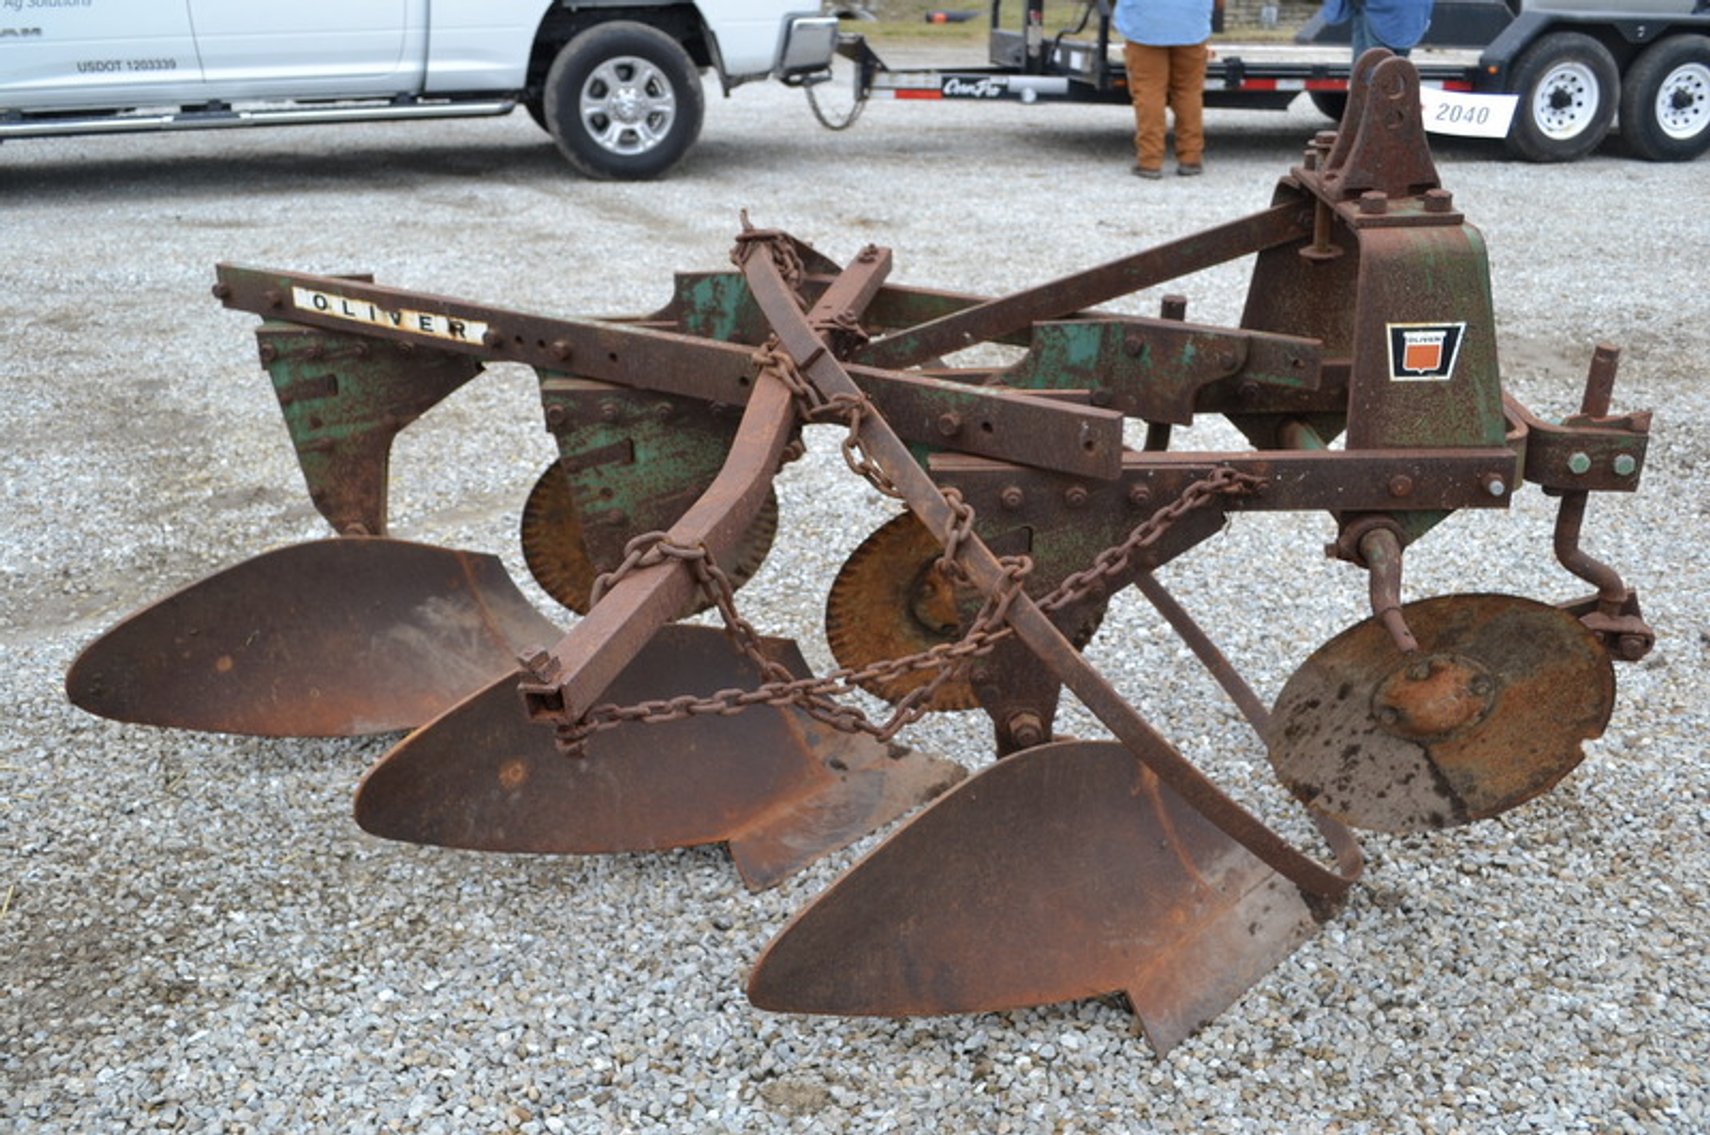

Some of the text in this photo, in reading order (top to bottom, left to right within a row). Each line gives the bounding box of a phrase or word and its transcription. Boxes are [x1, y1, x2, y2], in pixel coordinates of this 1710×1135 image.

[77, 60, 122, 74] USDOT
[1435, 103, 1490, 125] 2040
[312, 294, 467, 339] OLIVER
